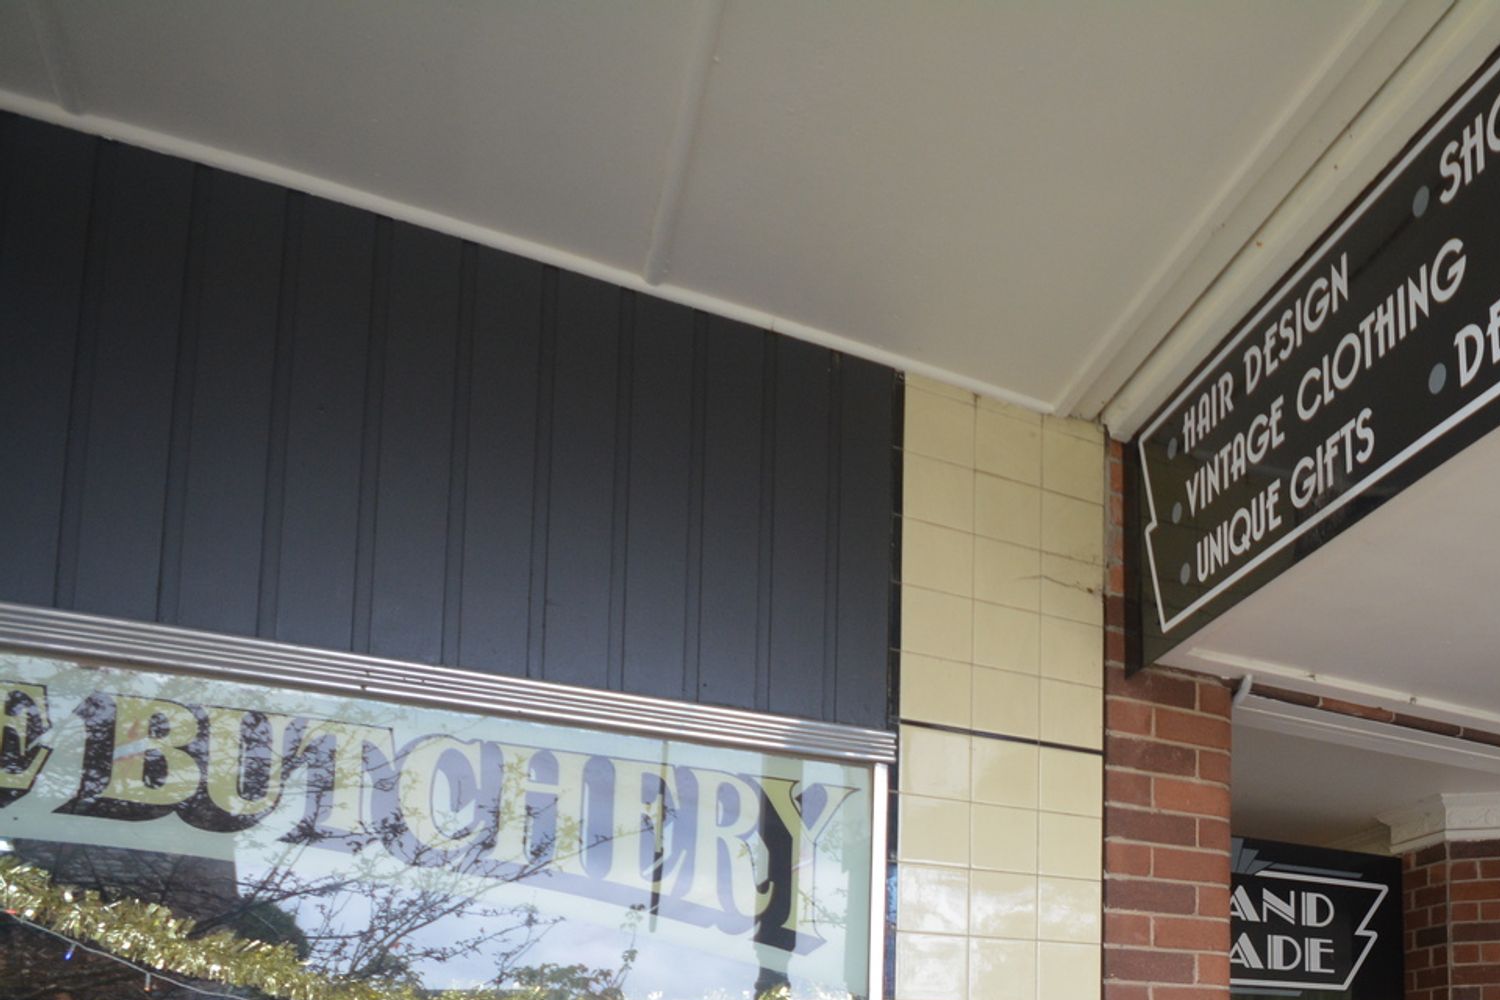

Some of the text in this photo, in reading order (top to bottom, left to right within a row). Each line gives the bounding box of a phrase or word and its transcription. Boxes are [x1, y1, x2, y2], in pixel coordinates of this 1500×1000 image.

[1183, 252, 1349, 454] HAIR DESIGN
[1185, 238, 1467, 517] VINTAGE CLOTHING
[1196, 408, 1376, 583] UNIQUE GIFTS
[56, 690, 862, 952] BUTCHERY
[1230, 884, 1335, 928] AND
[1230, 932, 1335, 974] ADE
